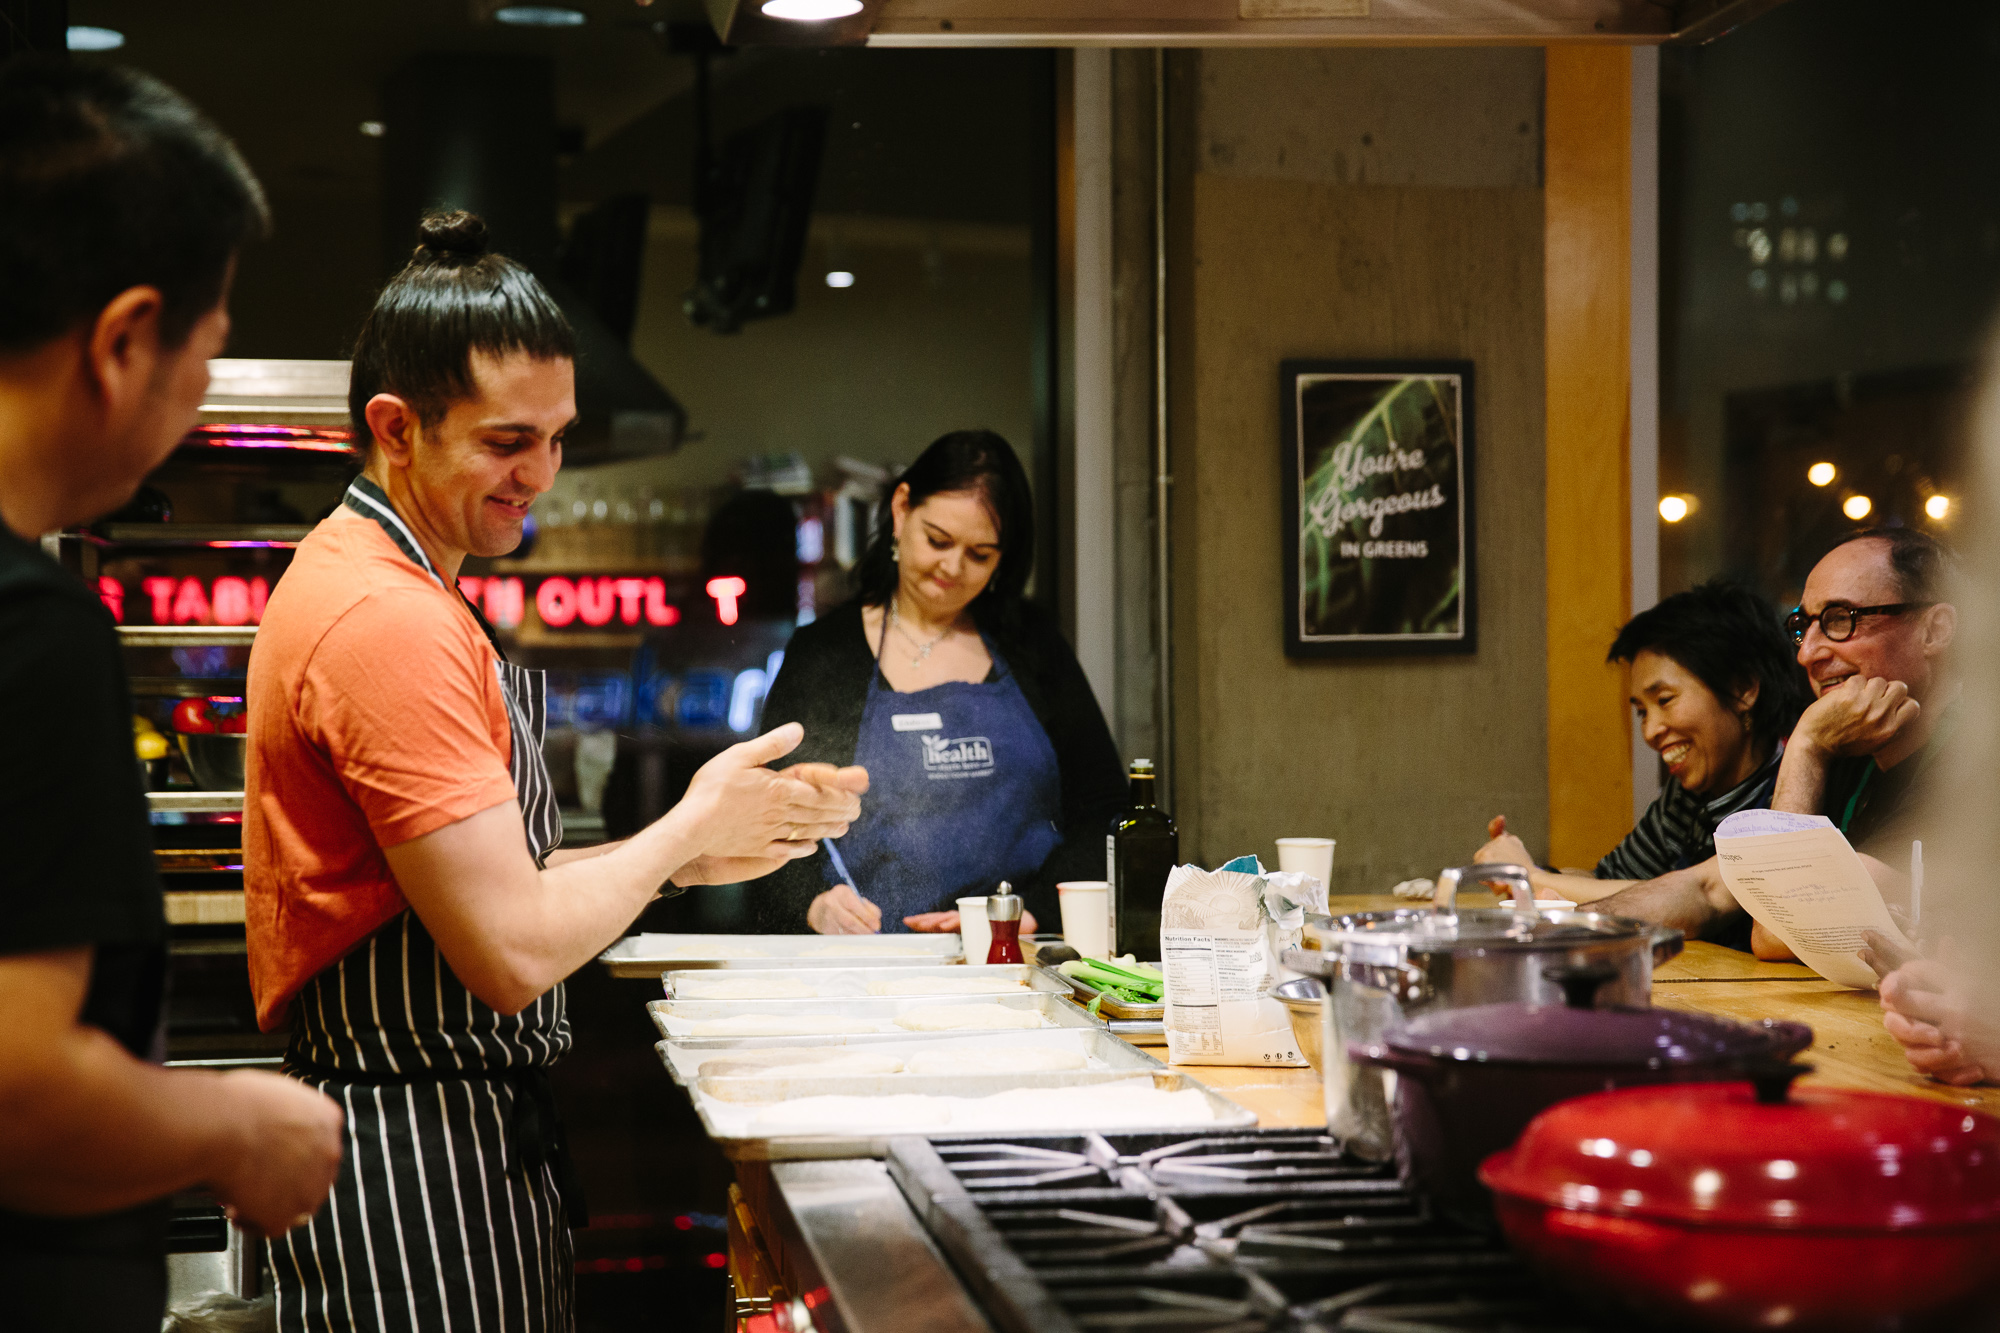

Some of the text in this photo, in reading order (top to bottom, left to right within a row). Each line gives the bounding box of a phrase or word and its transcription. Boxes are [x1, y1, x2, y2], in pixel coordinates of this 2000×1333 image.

[1331, 441, 1425, 491] You're
[1309, 485, 1446, 537] Gorgeous
[1340, 540, 1429, 558] IN GREENS
[928, 742, 988, 763] health
[1719, 853, 1743, 862] recipes
